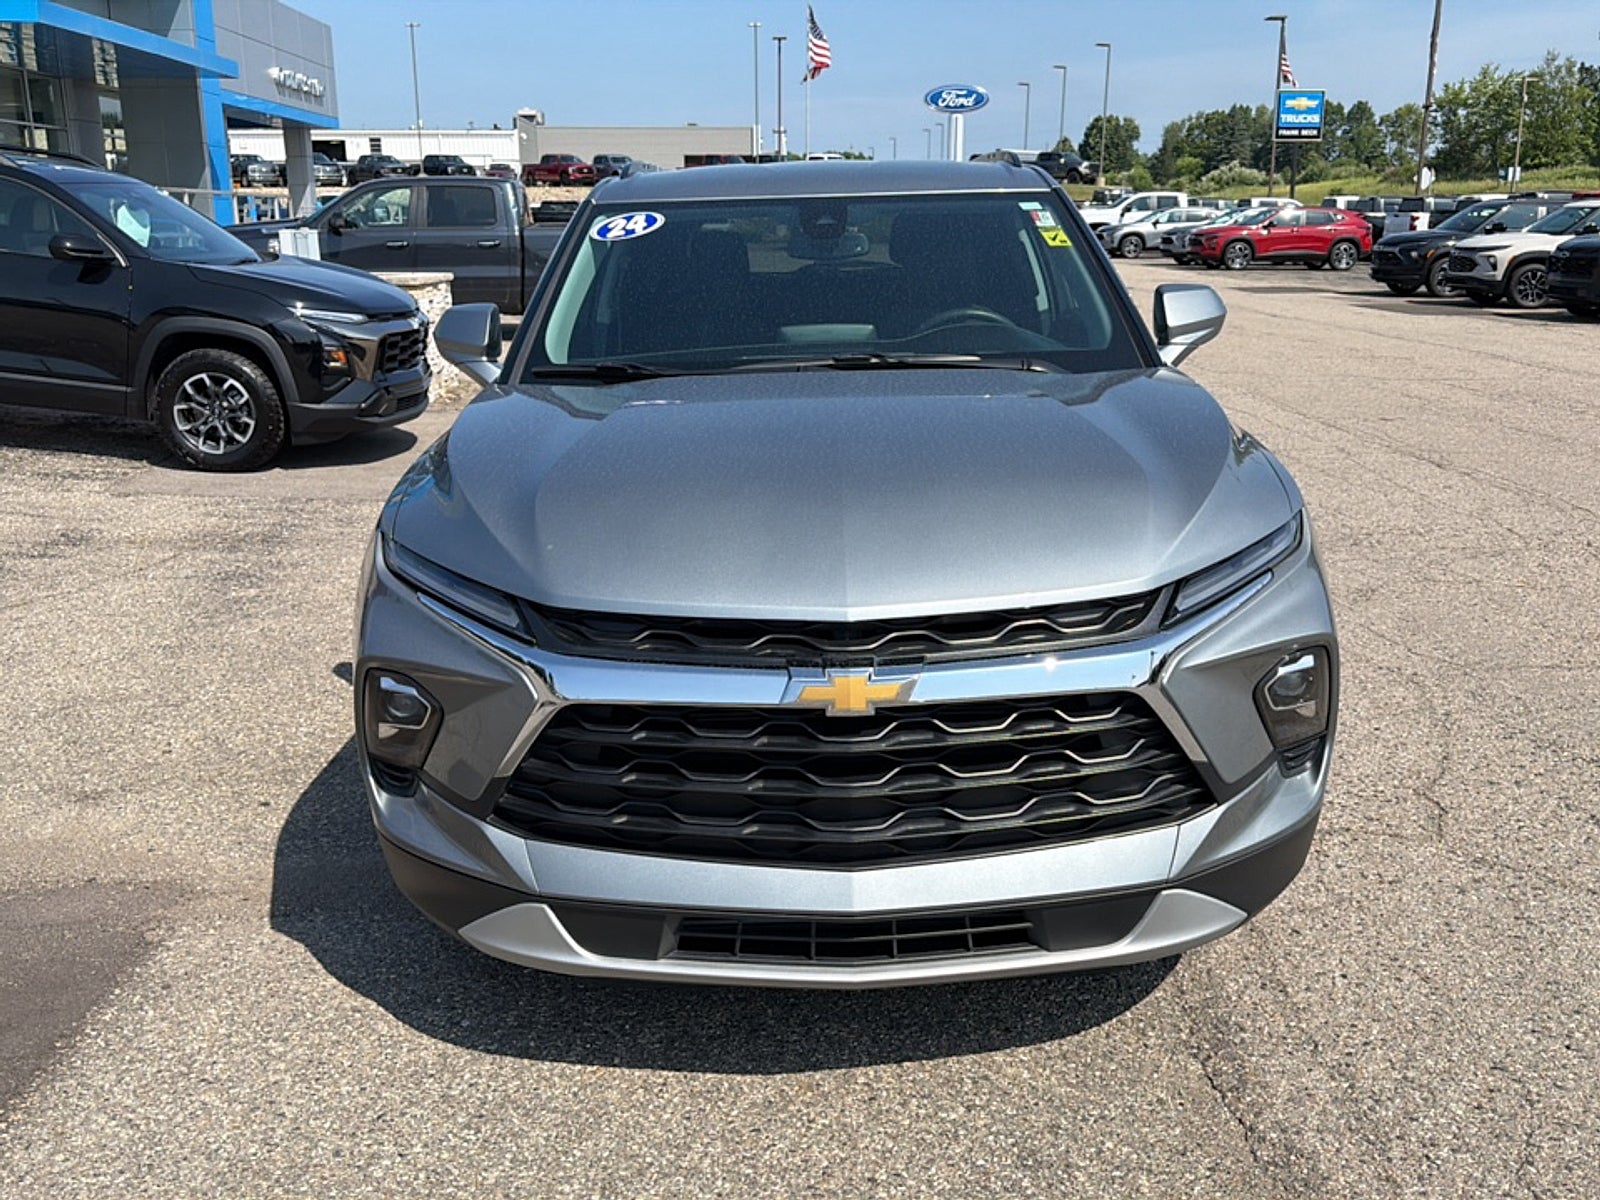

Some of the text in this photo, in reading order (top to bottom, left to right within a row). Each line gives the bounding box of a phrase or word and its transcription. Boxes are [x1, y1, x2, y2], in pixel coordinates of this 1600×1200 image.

[938, 90, 977, 107] Ford
[1281, 114, 1320, 123] TRUCKS
[606, 214, 648, 238] 24
